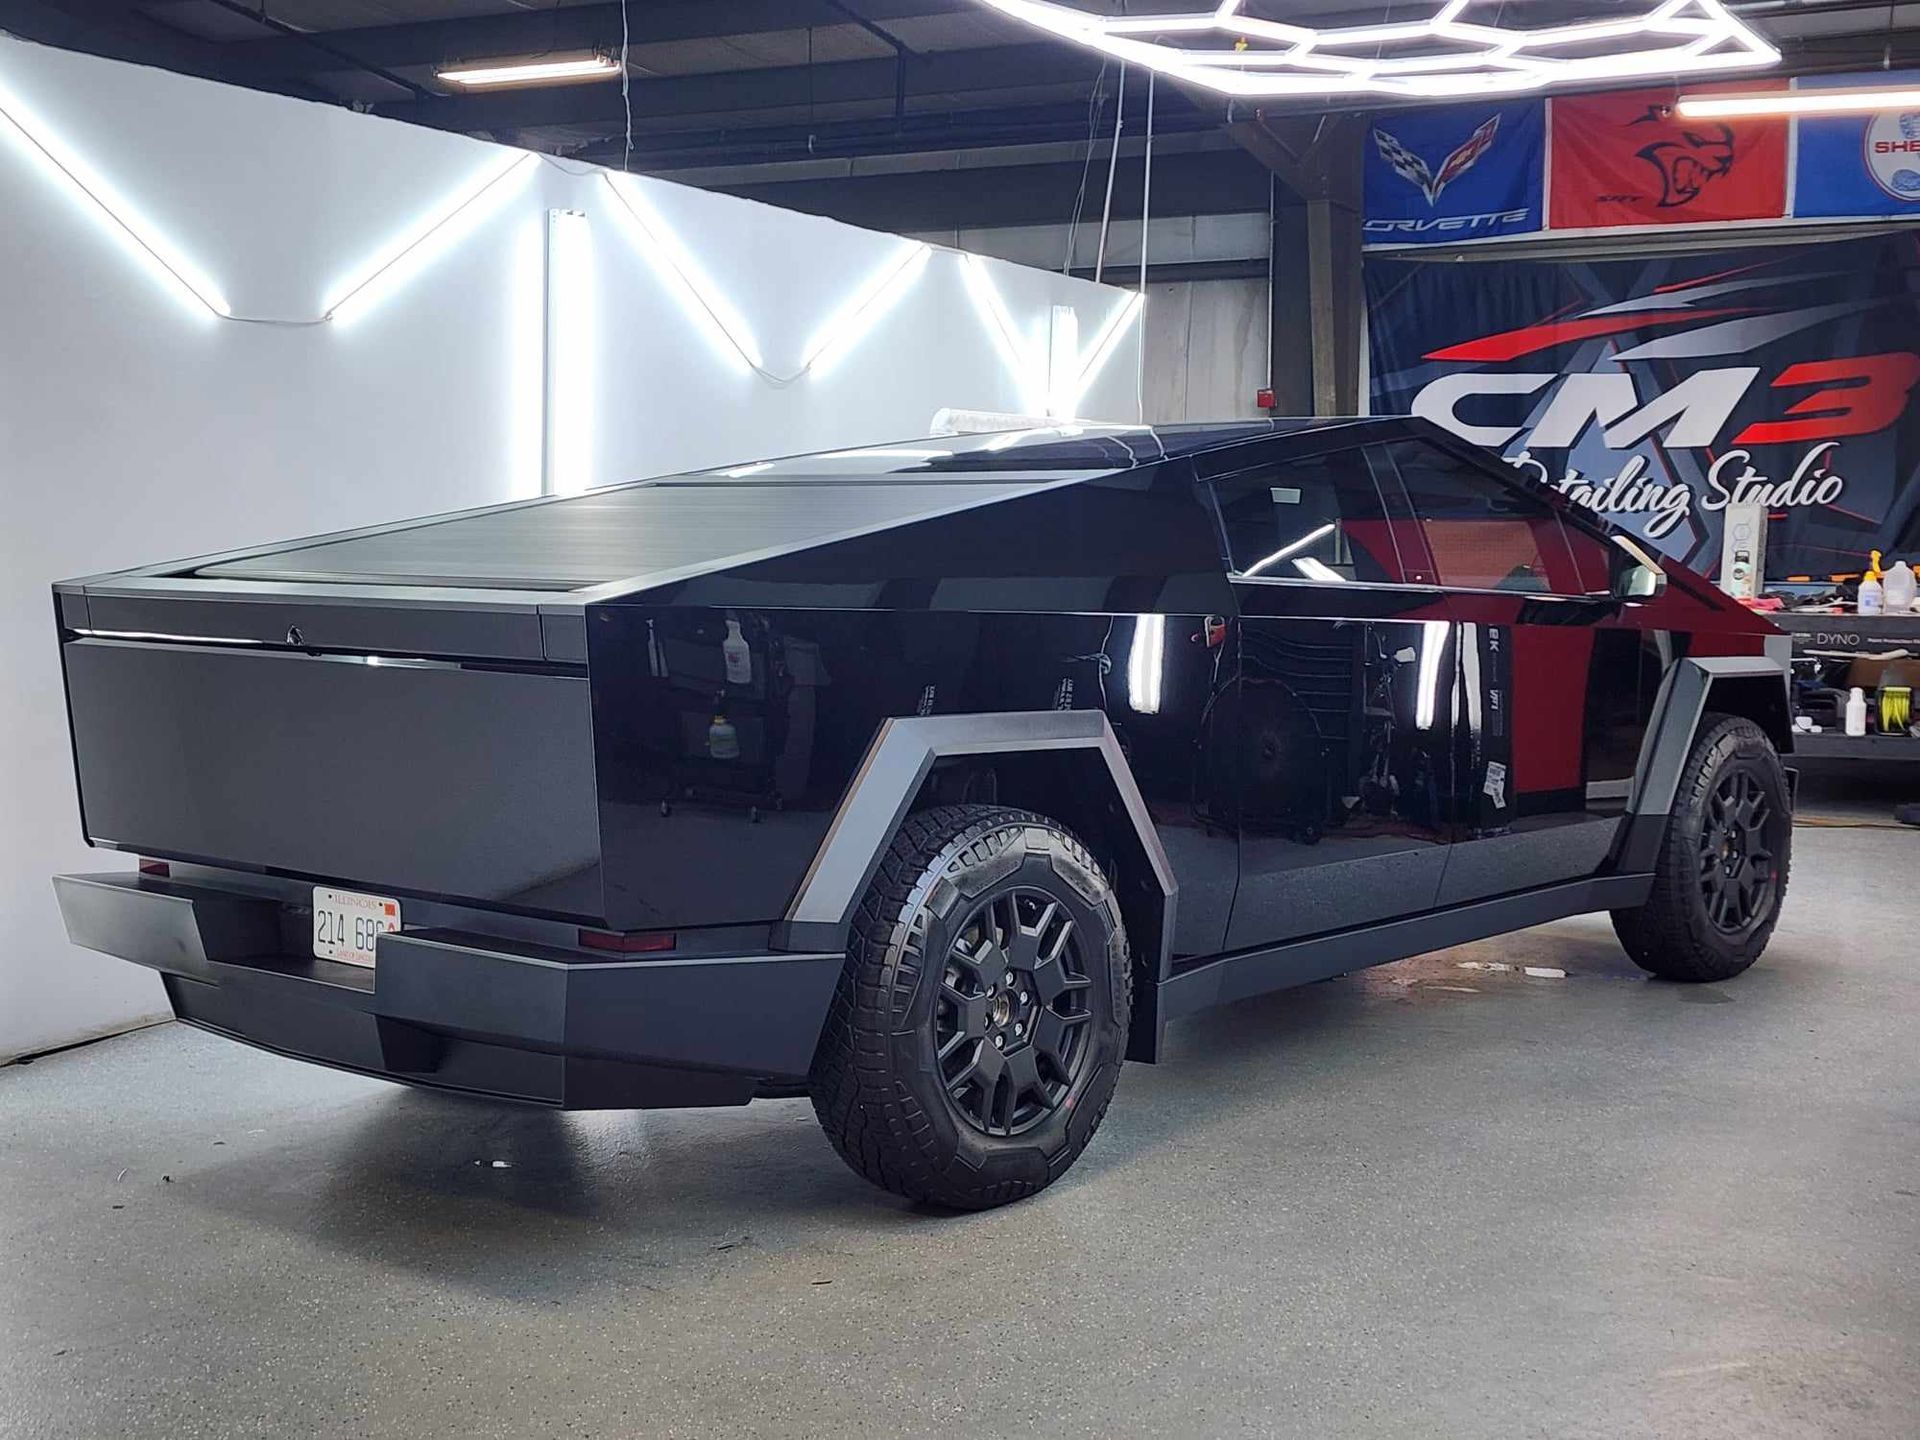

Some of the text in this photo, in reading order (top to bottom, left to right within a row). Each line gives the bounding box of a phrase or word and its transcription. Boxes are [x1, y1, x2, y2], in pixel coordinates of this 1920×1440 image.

[1362, 208, 1530, 232] ORVETTE
[1701, 441, 1843, 511] Studio
[1816, 632, 1860, 646] DYNO
[317, 910, 346, 947] 214
